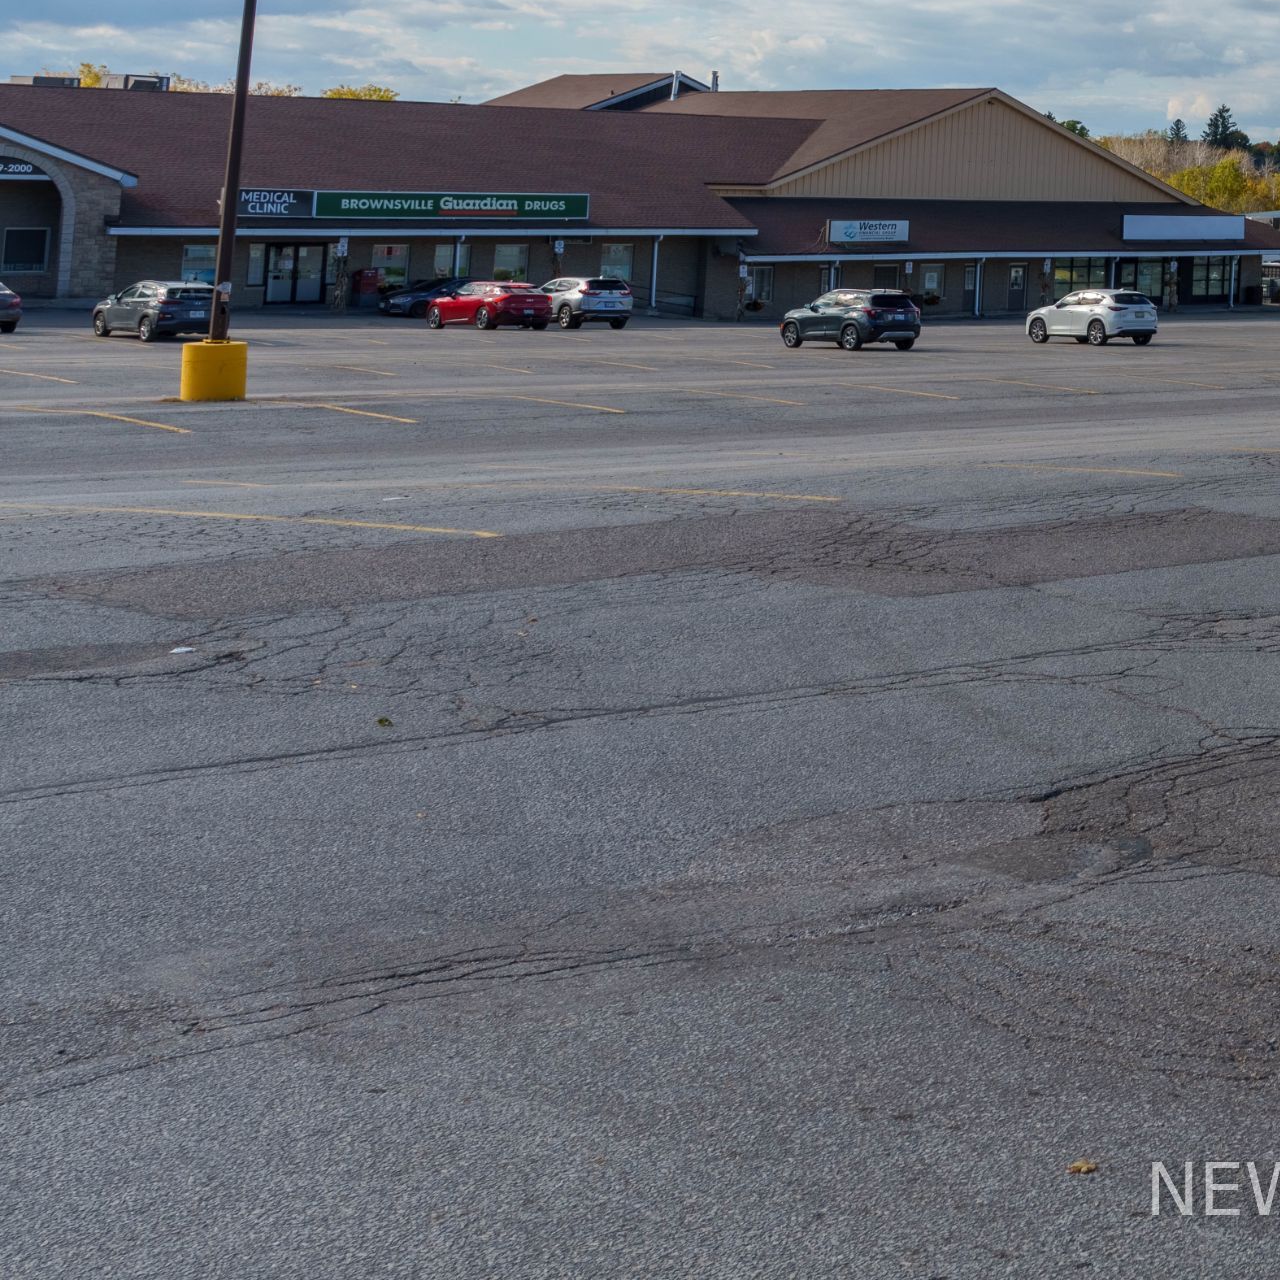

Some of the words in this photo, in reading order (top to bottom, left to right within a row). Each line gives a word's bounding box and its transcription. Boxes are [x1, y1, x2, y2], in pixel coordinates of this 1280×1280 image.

[241, 191, 297, 203] MEDICAL
[247, 202, 289, 214] CLINIC
[341, 198, 434, 210] BROWNSVILLE
[439, 196, 518, 210] Guardian
[524, 200, 566, 211] DRUGS
[859, 221, 897, 230] Western
